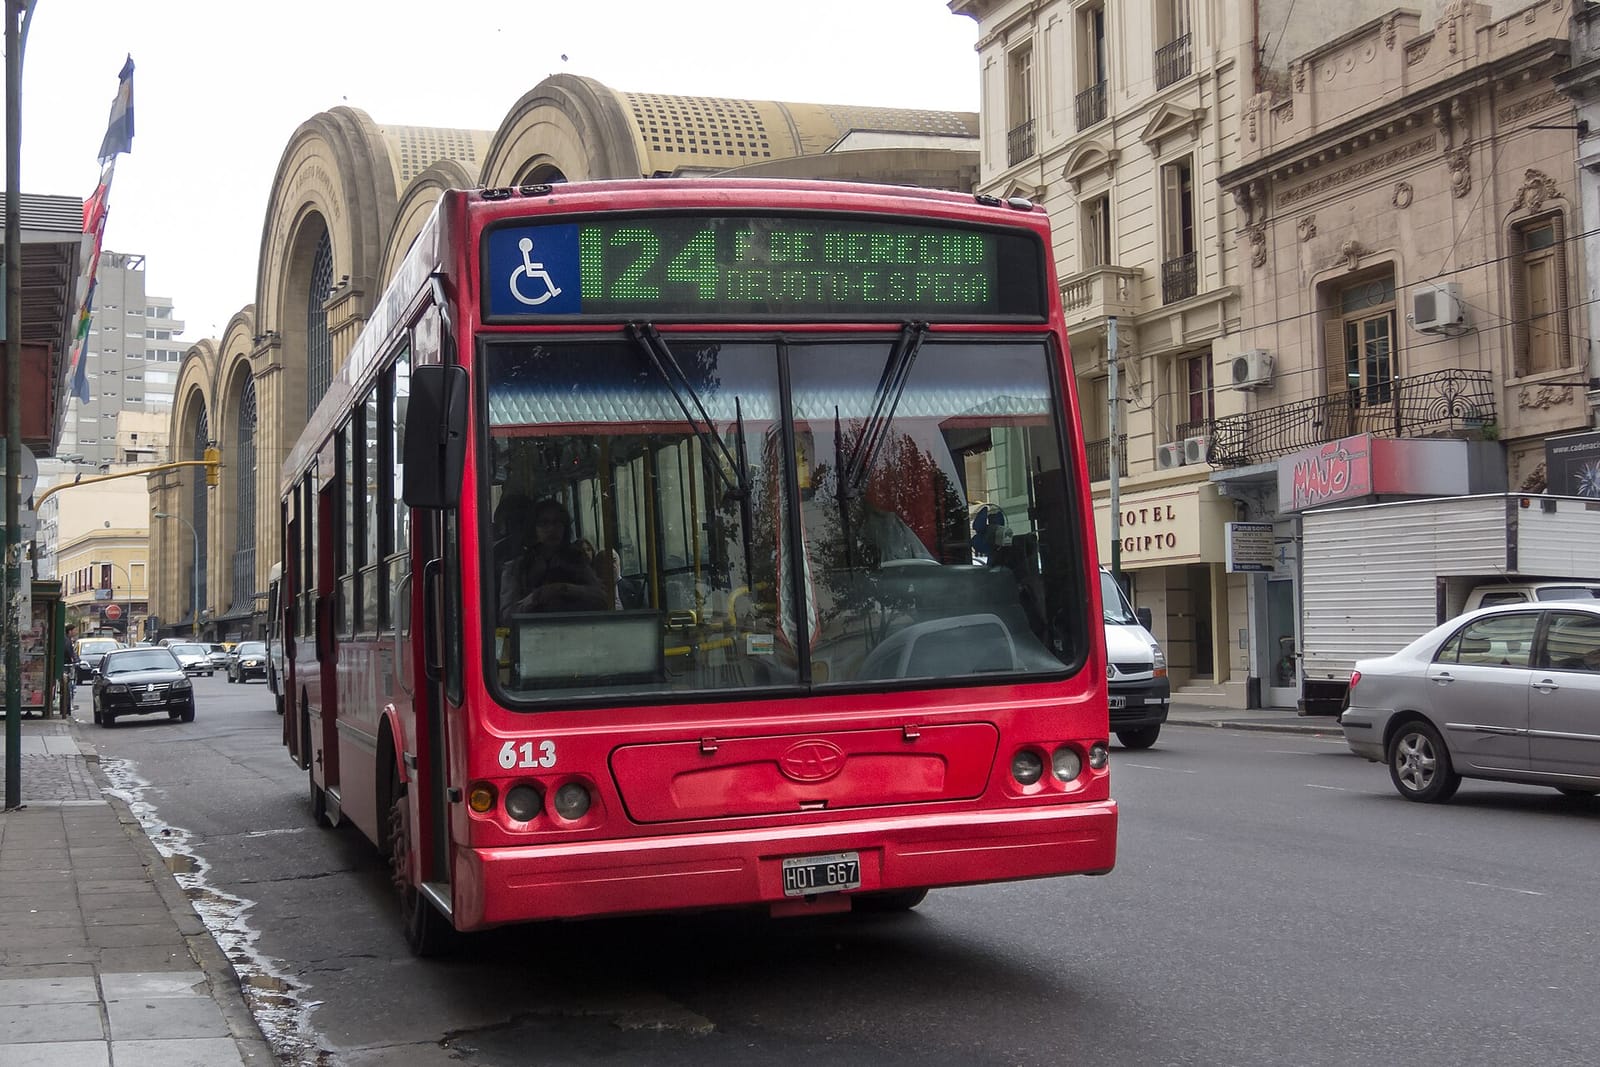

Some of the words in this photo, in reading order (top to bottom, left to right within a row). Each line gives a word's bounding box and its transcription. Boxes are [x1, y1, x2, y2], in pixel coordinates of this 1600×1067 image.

[580, 228, 720, 299] 124
[735, 231, 755, 262] F.
[770, 231, 814, 263] DE
[825, 232, 984, 265] DERECHO
[1232, 524, 1272, 532] Panasonic
[498, 740, 557, 769] 613
[786, 866, 816, 889] HOT
[826, 861, 857, 885] 667
